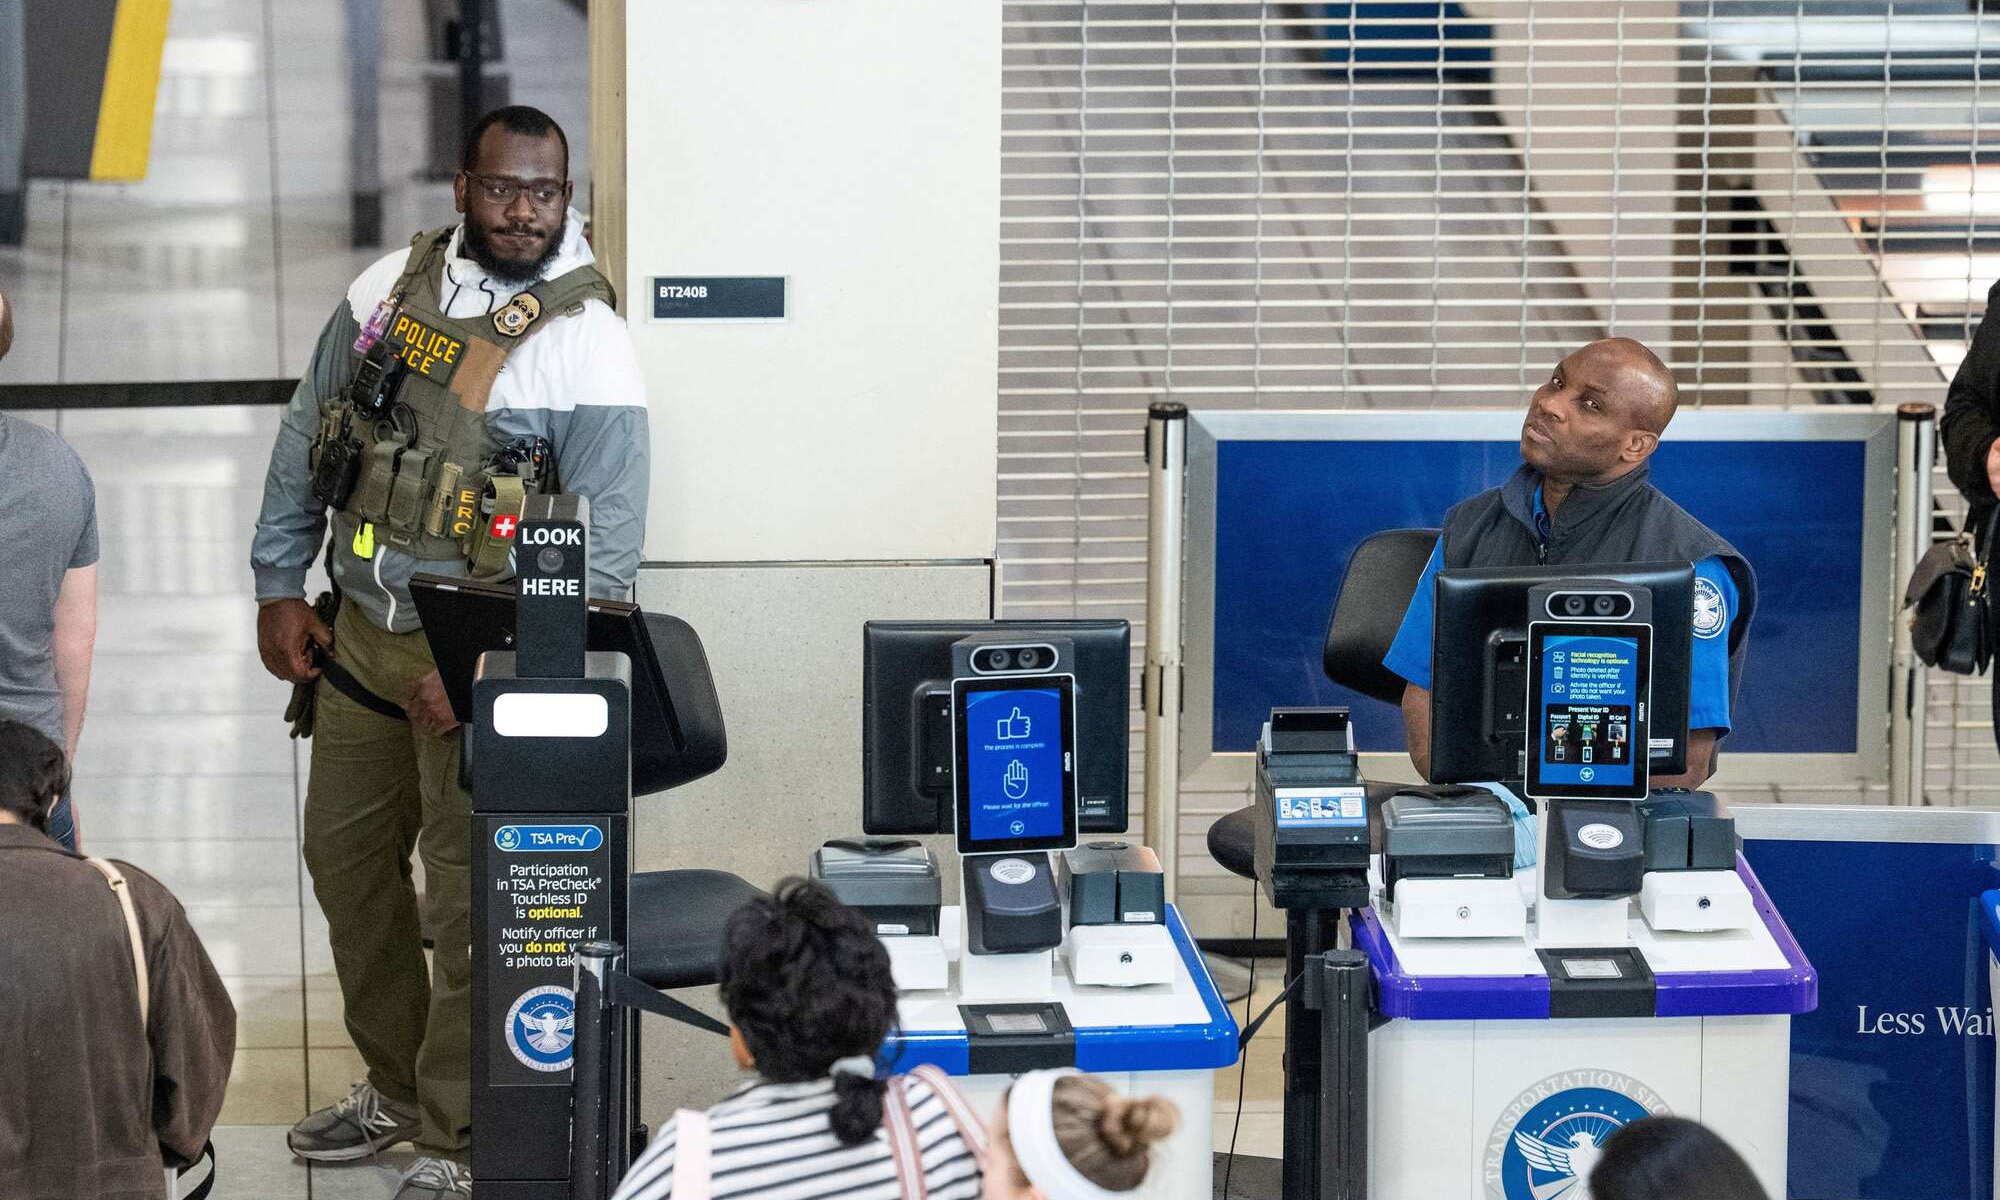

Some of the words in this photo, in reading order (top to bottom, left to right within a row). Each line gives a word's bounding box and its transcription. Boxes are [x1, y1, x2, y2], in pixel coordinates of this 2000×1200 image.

[660, 286, 709, 298] BT240B
[394, 316, 461, 364] POLICE
[402, 346, 435, 375] ICE
[522, 528, 582, 546] LOOK
[522, 578, 580, 596] HERE
[530, 833, 554, 845] TSA
[510, 864, 588, 878] Participation
[497, 878, 509, 891] in
[511, 879, 536, 891] TSA
[511, 893, 571, 905] Touchless
[574, 893, 588, 905] ID
[515, 907, 526, 919] is
[528, 907, 583, 920] optional.
[502, 927, 542, 941] Notify
[544, 927, 585, 939] officer
[588, 927, 598, 939] if
[499, 943, 523, 955] you
[525, 941, 543, 953] do
[544, 941, 567, 953] not
[506, 957, 514, 967] a
[517, 955, 553, 969] photo
[557, 955, 576, 967] tak
[1857, 1005, 1926, 1035] Less
[1935, 1006, 1993, 1036] Wai
[1486, 1071, 1633, 1184] TRANSPORTATION
